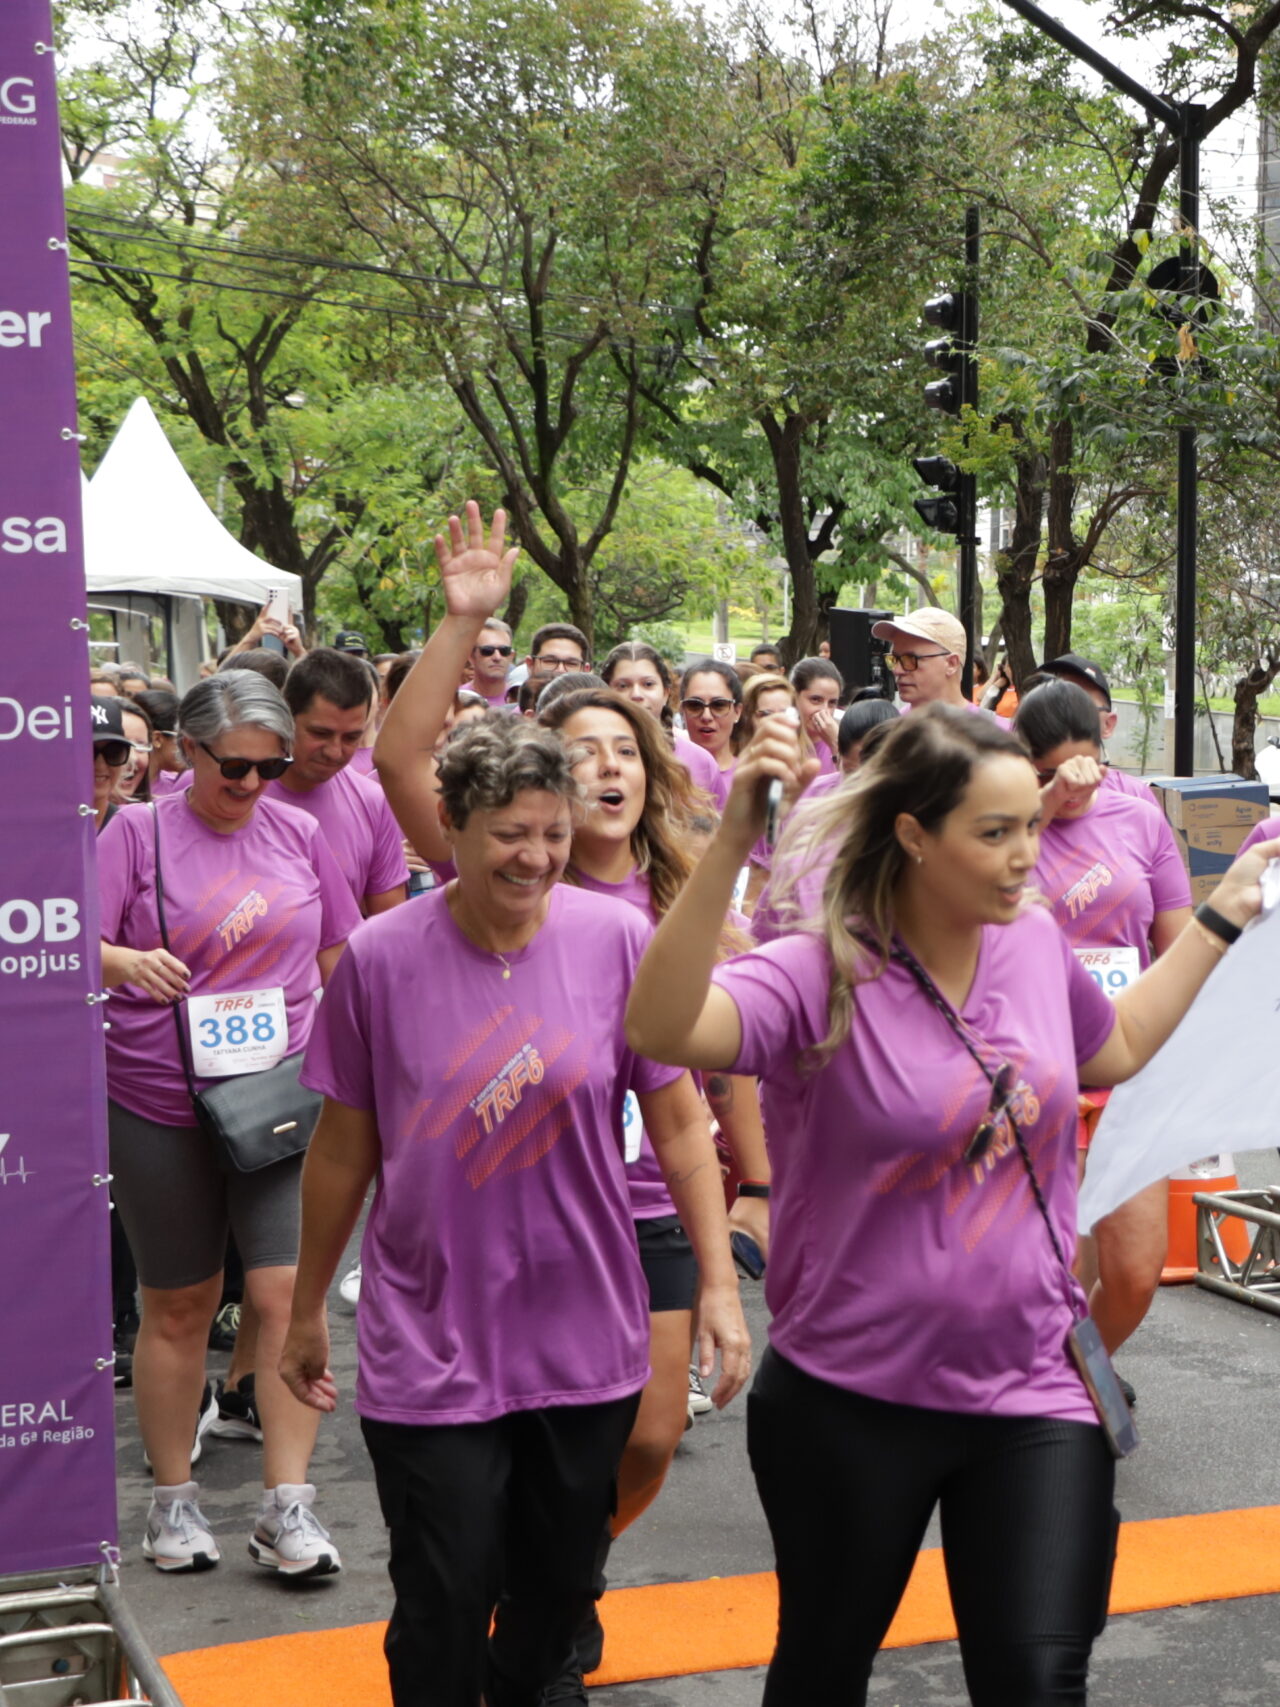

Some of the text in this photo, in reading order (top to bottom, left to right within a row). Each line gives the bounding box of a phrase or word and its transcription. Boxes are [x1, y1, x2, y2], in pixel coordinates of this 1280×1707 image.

[0, 117, 37, 125] EDERAIS
[220, 893, 268, 951] TRF6
[0, 949, 81, 978] opjus
[215, 997, 254, 1012] TRF6
[198, 1012, 275, 1048] 388
[475, 1049, 544, 1134] TRF6
[20, 1431, 38, 1446] 6ª
[43, 1426, 94, 1444] Região
